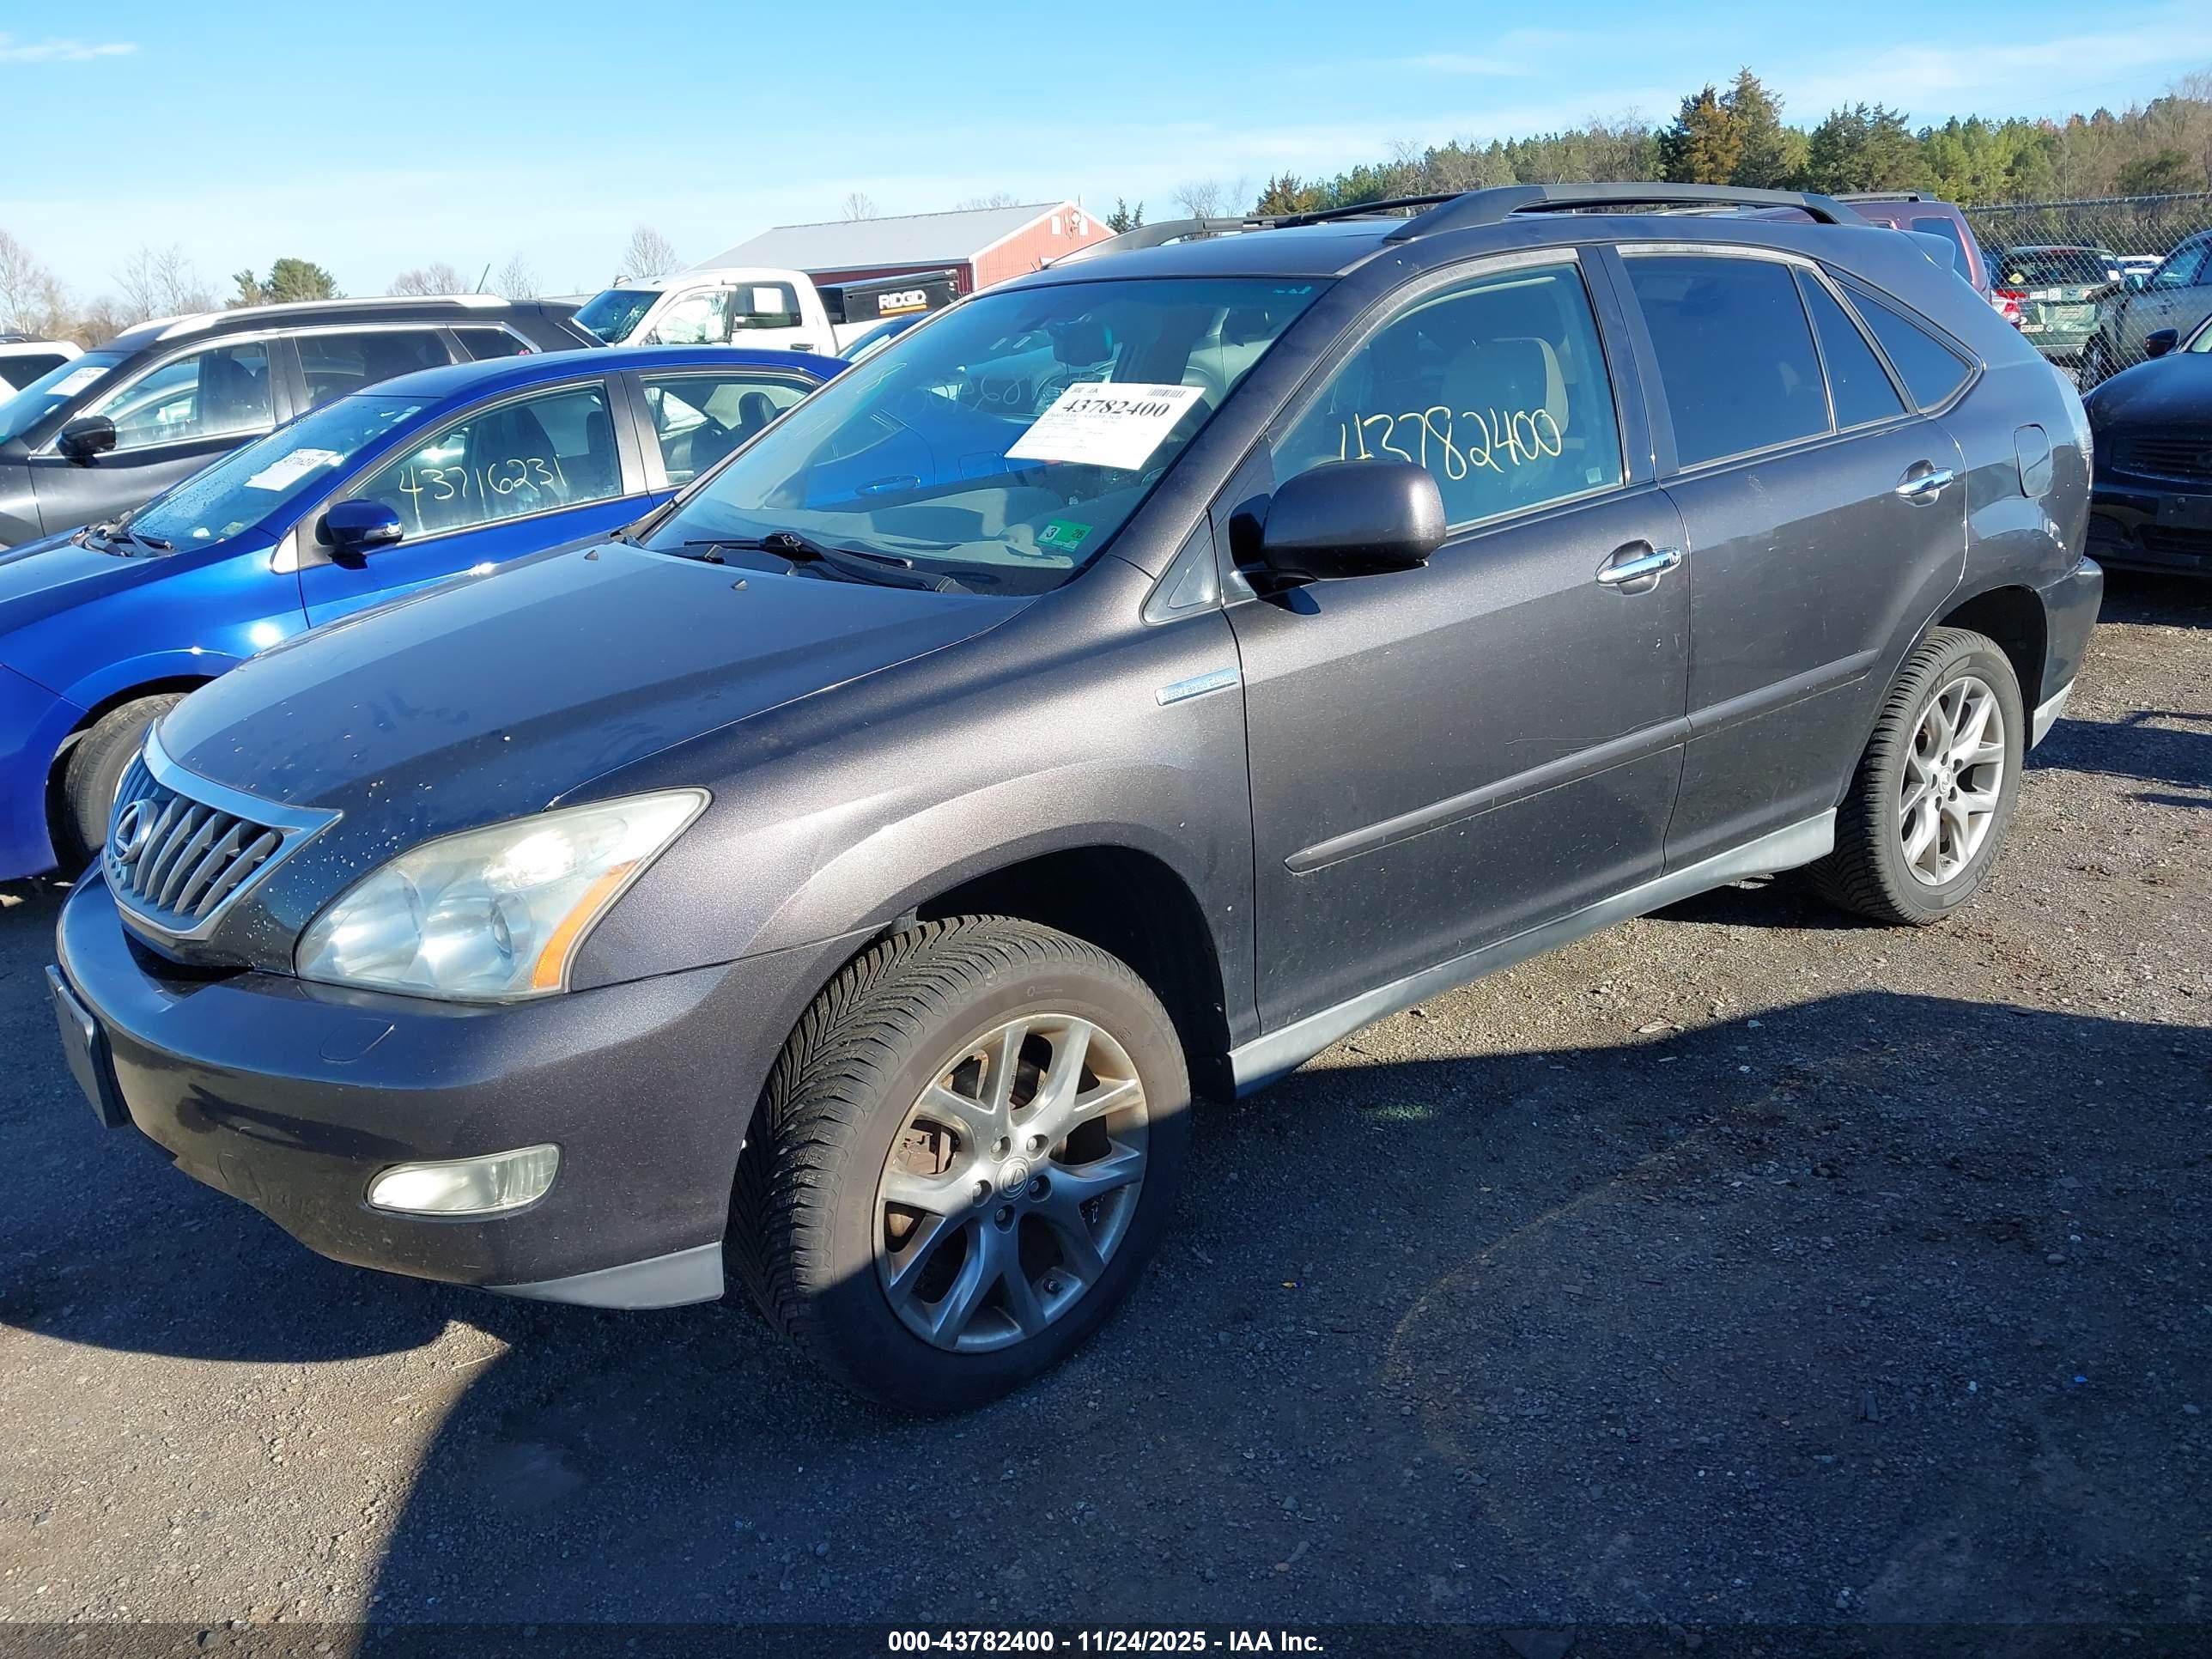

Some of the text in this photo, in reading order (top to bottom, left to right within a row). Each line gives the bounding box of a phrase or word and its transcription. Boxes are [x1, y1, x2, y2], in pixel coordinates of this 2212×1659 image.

[878, 290, 927, 309] RIDGID
[1063, 399, 1170, 417] 43782400
[1340, 406, 1562, 480] 43782400
[398, 458, 568, 526] 43716231
[1046, 527, 1058, 538] 3
